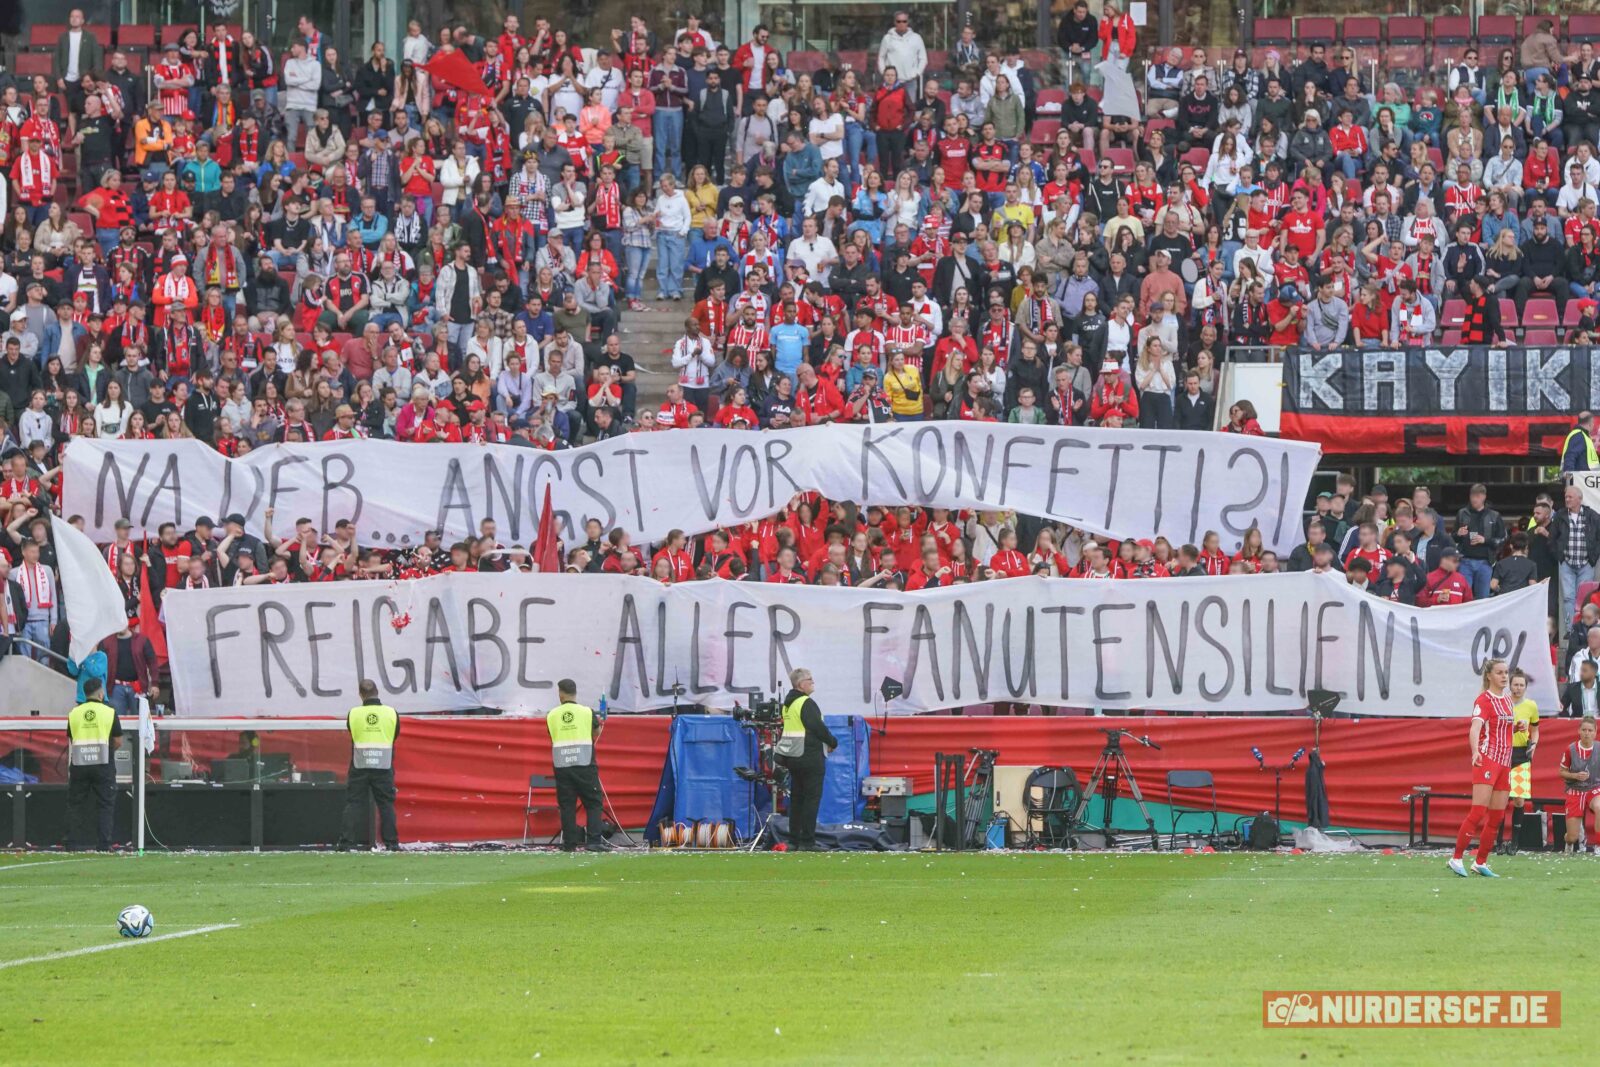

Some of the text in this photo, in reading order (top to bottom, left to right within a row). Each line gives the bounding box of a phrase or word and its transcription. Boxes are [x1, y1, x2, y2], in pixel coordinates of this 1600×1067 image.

[771, 404, 791, 413] FILA
[94, 452, 181, 529] NA
[440, 449, 649, 541] ANGST
[690, 439, 802, 521] VOR
[206, 597, 557, 699] FREIGABE
[610, 592, 801, 700] ALLER
[863, 594, 1426, 706] FANUTENSILIEN!
